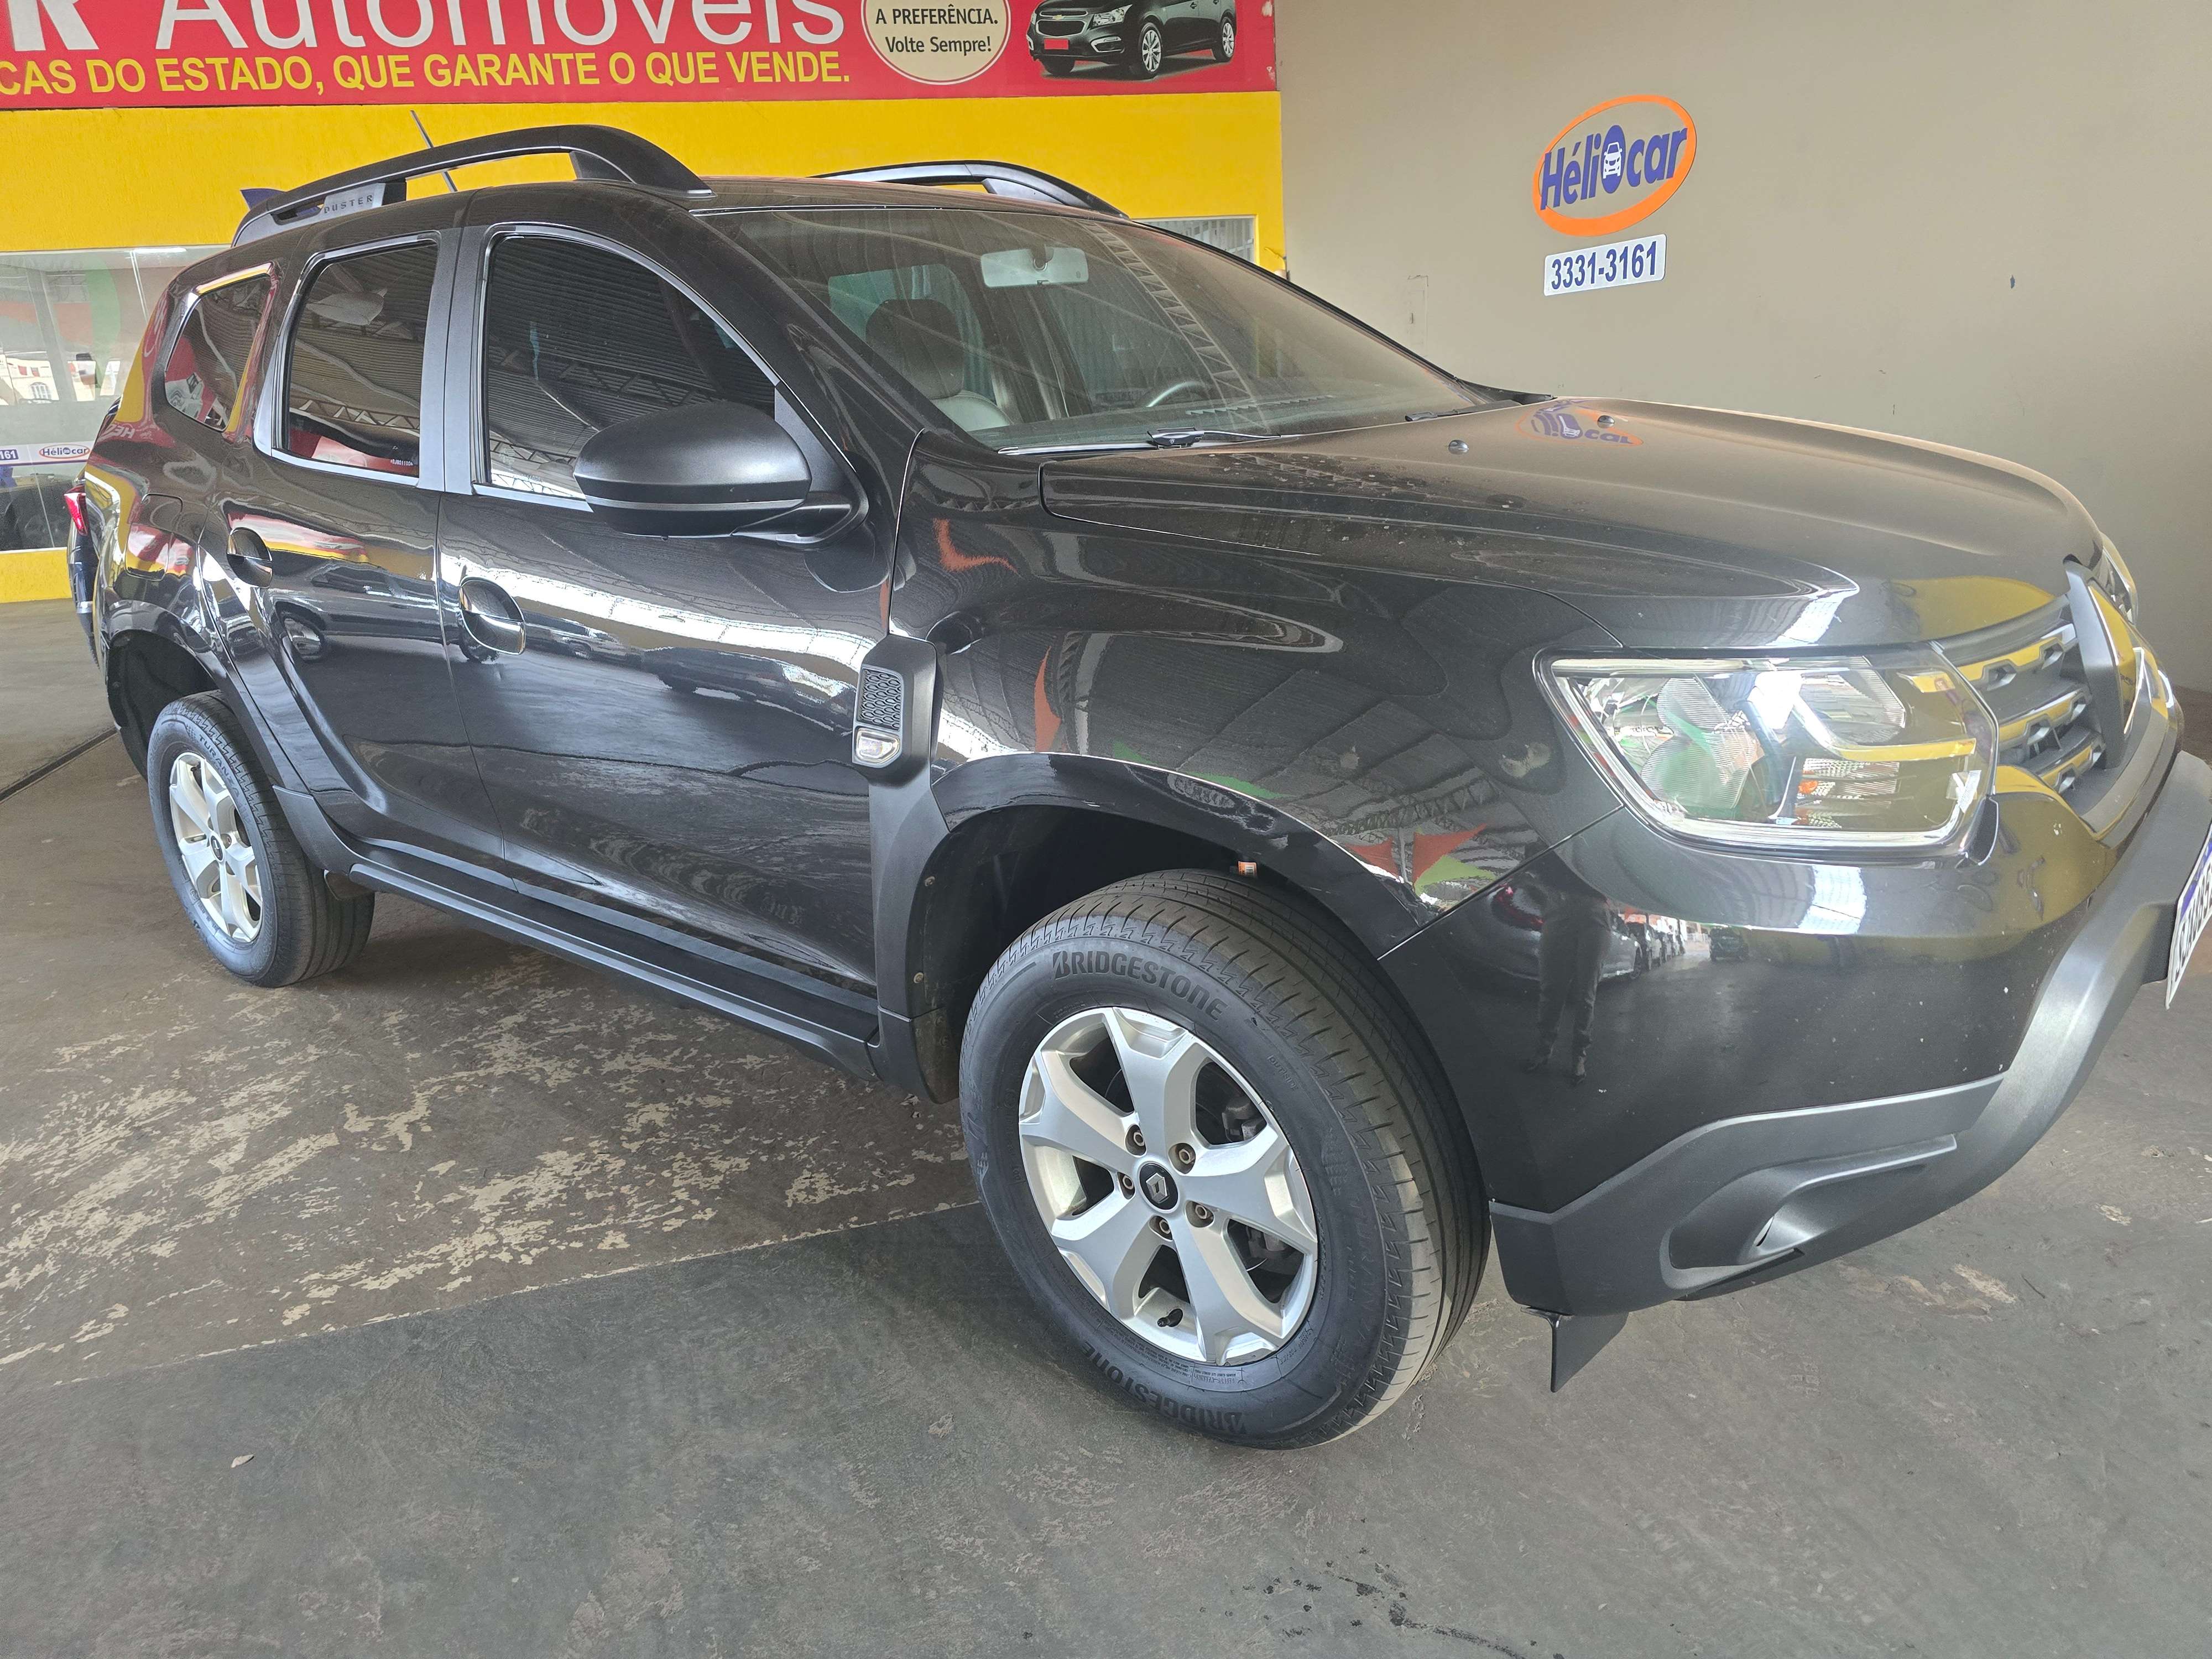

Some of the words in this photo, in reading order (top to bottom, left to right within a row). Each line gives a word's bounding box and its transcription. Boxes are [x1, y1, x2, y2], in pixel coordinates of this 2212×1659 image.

[875, 8, 888, 24] A
[892, 4, 999, 24] PREFERÊNCIA.
[885, 36, 925, 53] Volte
[930, 36, 992, 56] Sempre!
[0, 59, 76, 95] CAS
[85, 58, 146, 93] DO
[159, 55, 325, 96] ESTADO,
[333, 54, 415, 91] QUE
[424, 52, 601, 87] GARANTE
[609, 51, 636, 85] O
[645, 51, 719, 87] QUE
[726, 51, 850, 83] VENDE.
[324, 195, 374, 214] DUSTER
[1551, 240, 1657, 290] 3331-3161
[1052, 950, 1229, 1021] BRIDGESTONE
